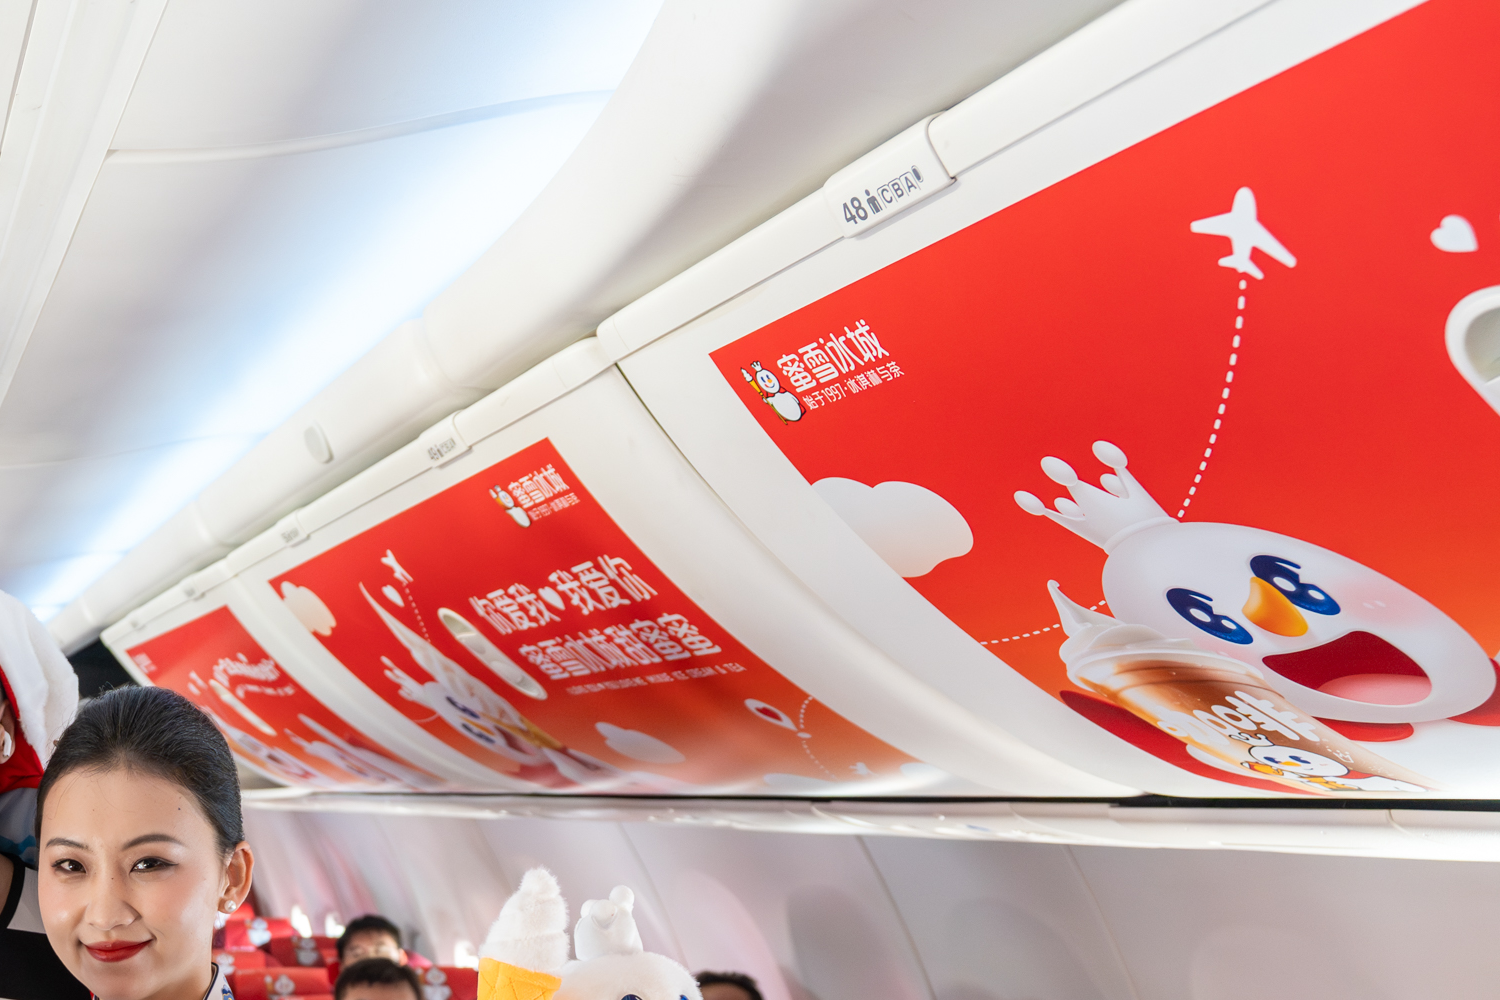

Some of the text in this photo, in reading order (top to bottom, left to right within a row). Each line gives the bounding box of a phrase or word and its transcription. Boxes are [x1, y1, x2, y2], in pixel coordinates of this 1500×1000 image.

[842, 196, 869, 224] 48
[776, 318, 890, 393] 蜜雪冰城
[508, 463, 570, 509] 蜜雪冰城
[470, 554, 659, 635] 你爱我 我爱你
[518, 612, 722, 680] 蜜雪冰城甜蜜蜜
